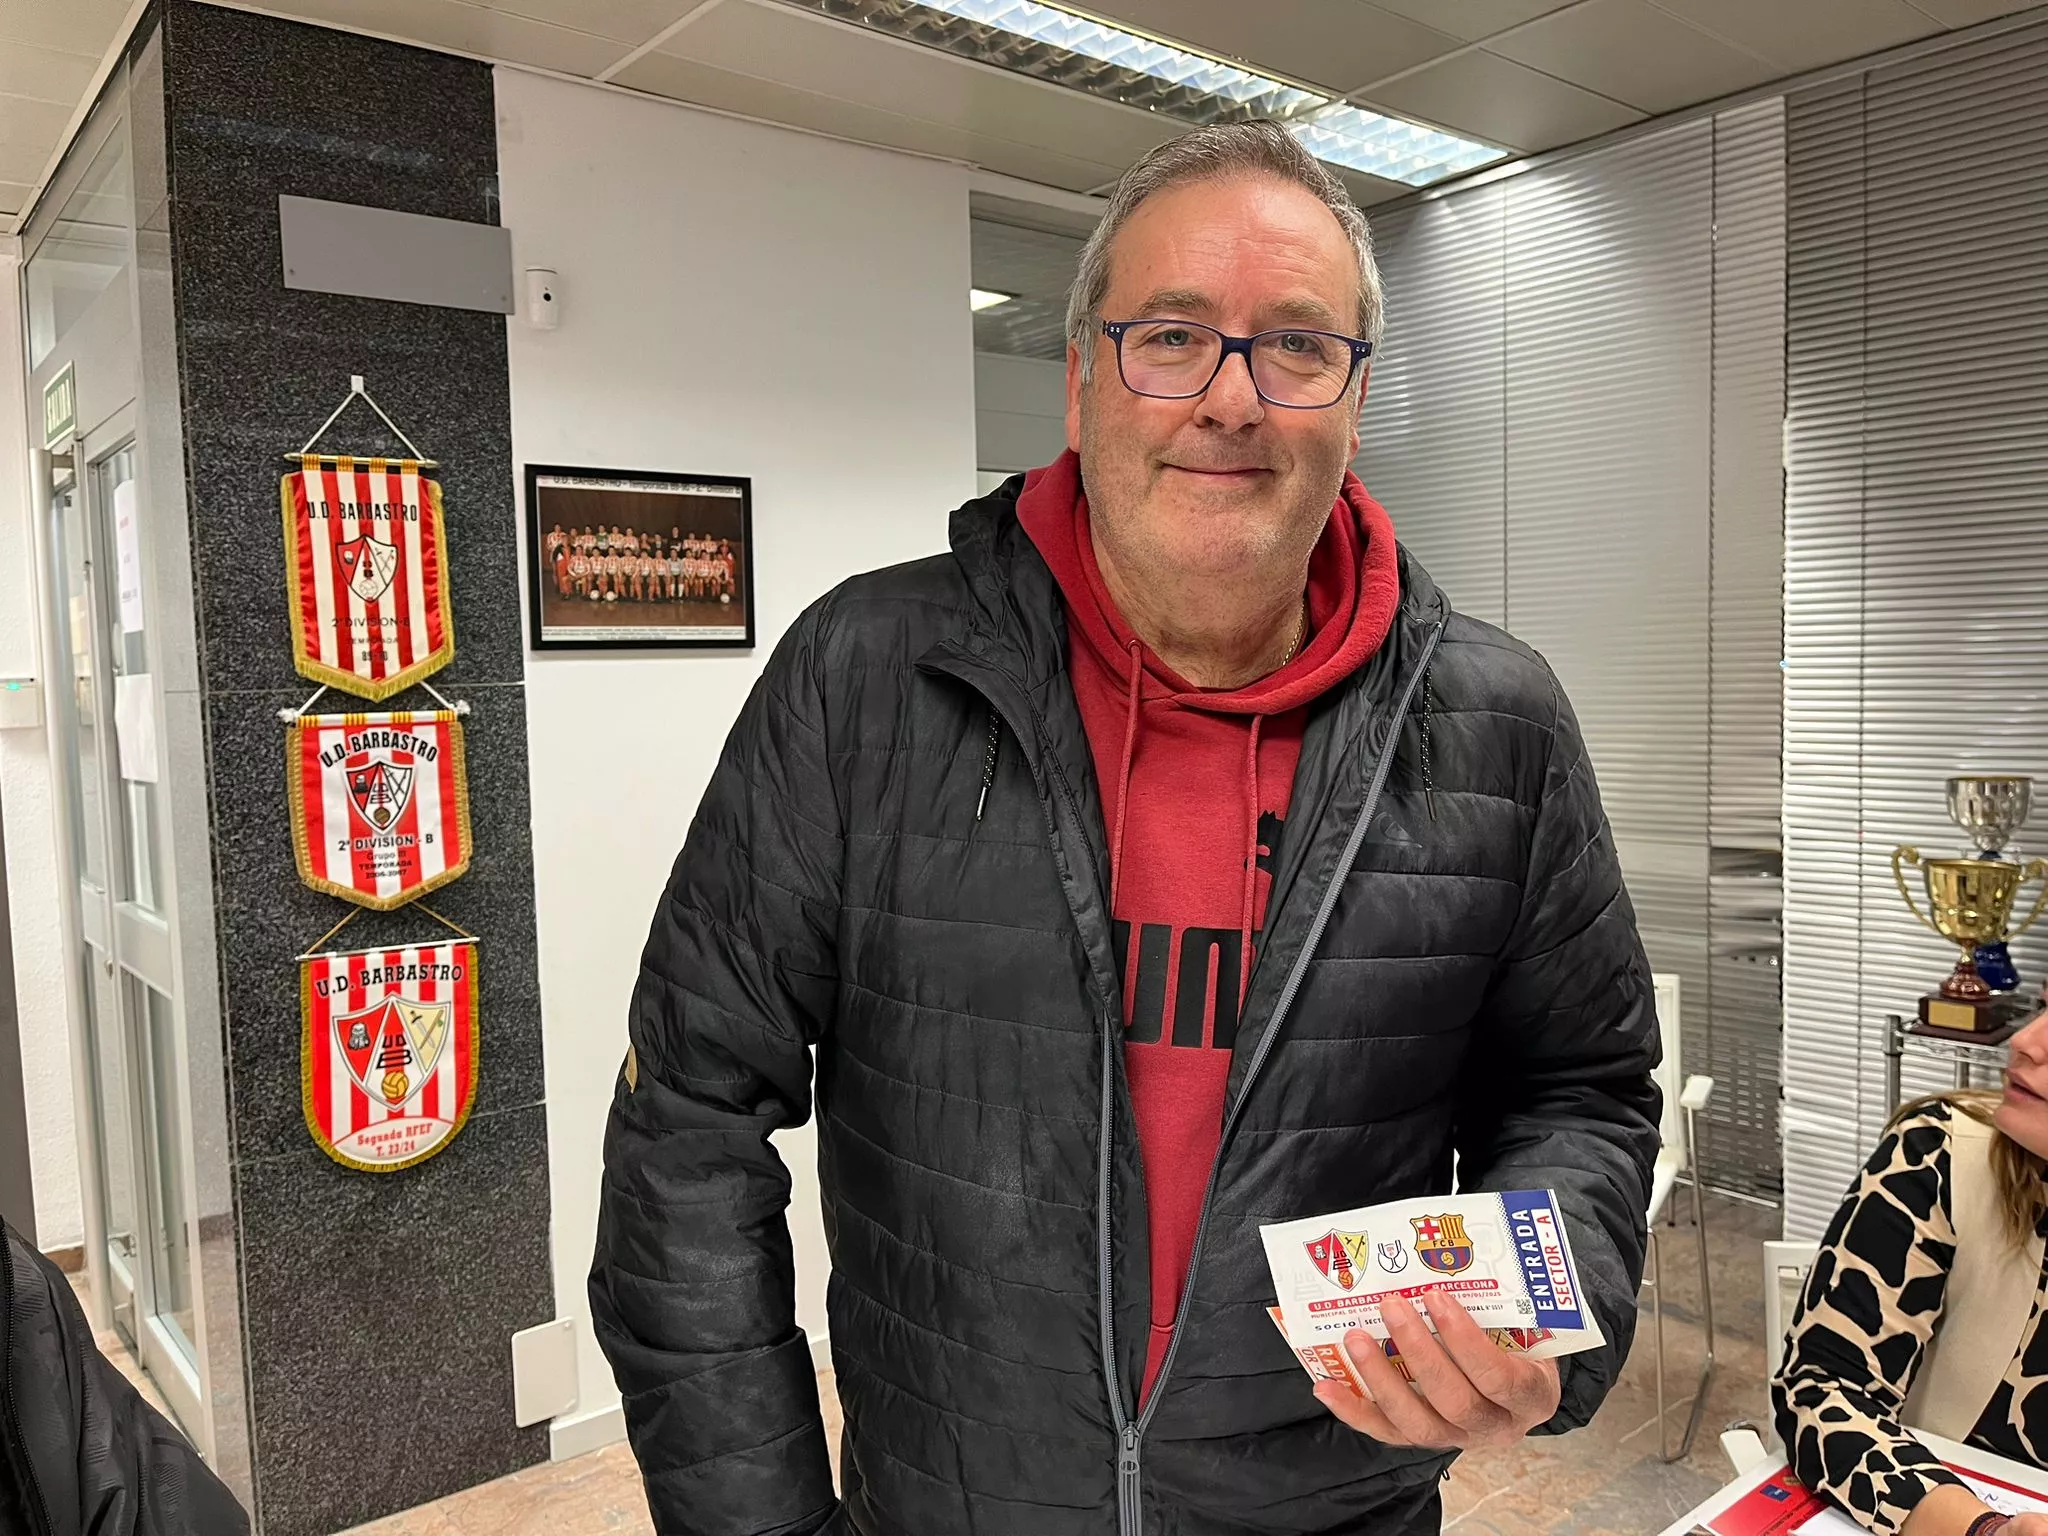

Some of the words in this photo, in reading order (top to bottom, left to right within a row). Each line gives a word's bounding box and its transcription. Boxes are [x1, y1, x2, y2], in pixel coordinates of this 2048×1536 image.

[339, 502, 418, 522] BARBASTRO
[320, 744, 350, 768] U.D.
[351, 732, 438, 762] BARBASTRO
[355, 836, 413, 850] DIVISION
[426, 833, 434, 844] B
[359, 860, 412, 870] TEMPORADA
[316, 976, 355, 996] U.D.
[360, 964, 463, 986] BARBASTRO
[357, 1130, 402, 1146] Segunda
[1536, 1215, 1552, 1225] A
[1432, 1240, 1455, 1248] FCB
[1511, 1209, 1555, 1311] ENTRADA
[1544, 1245, 1573, 1306] SECTOR
[1313, 1302, 1336, 1311] U.D.
[1315, 1321, 1356, 1331] SOCIO
[1365, 1317, 1381, 1326] SECT
